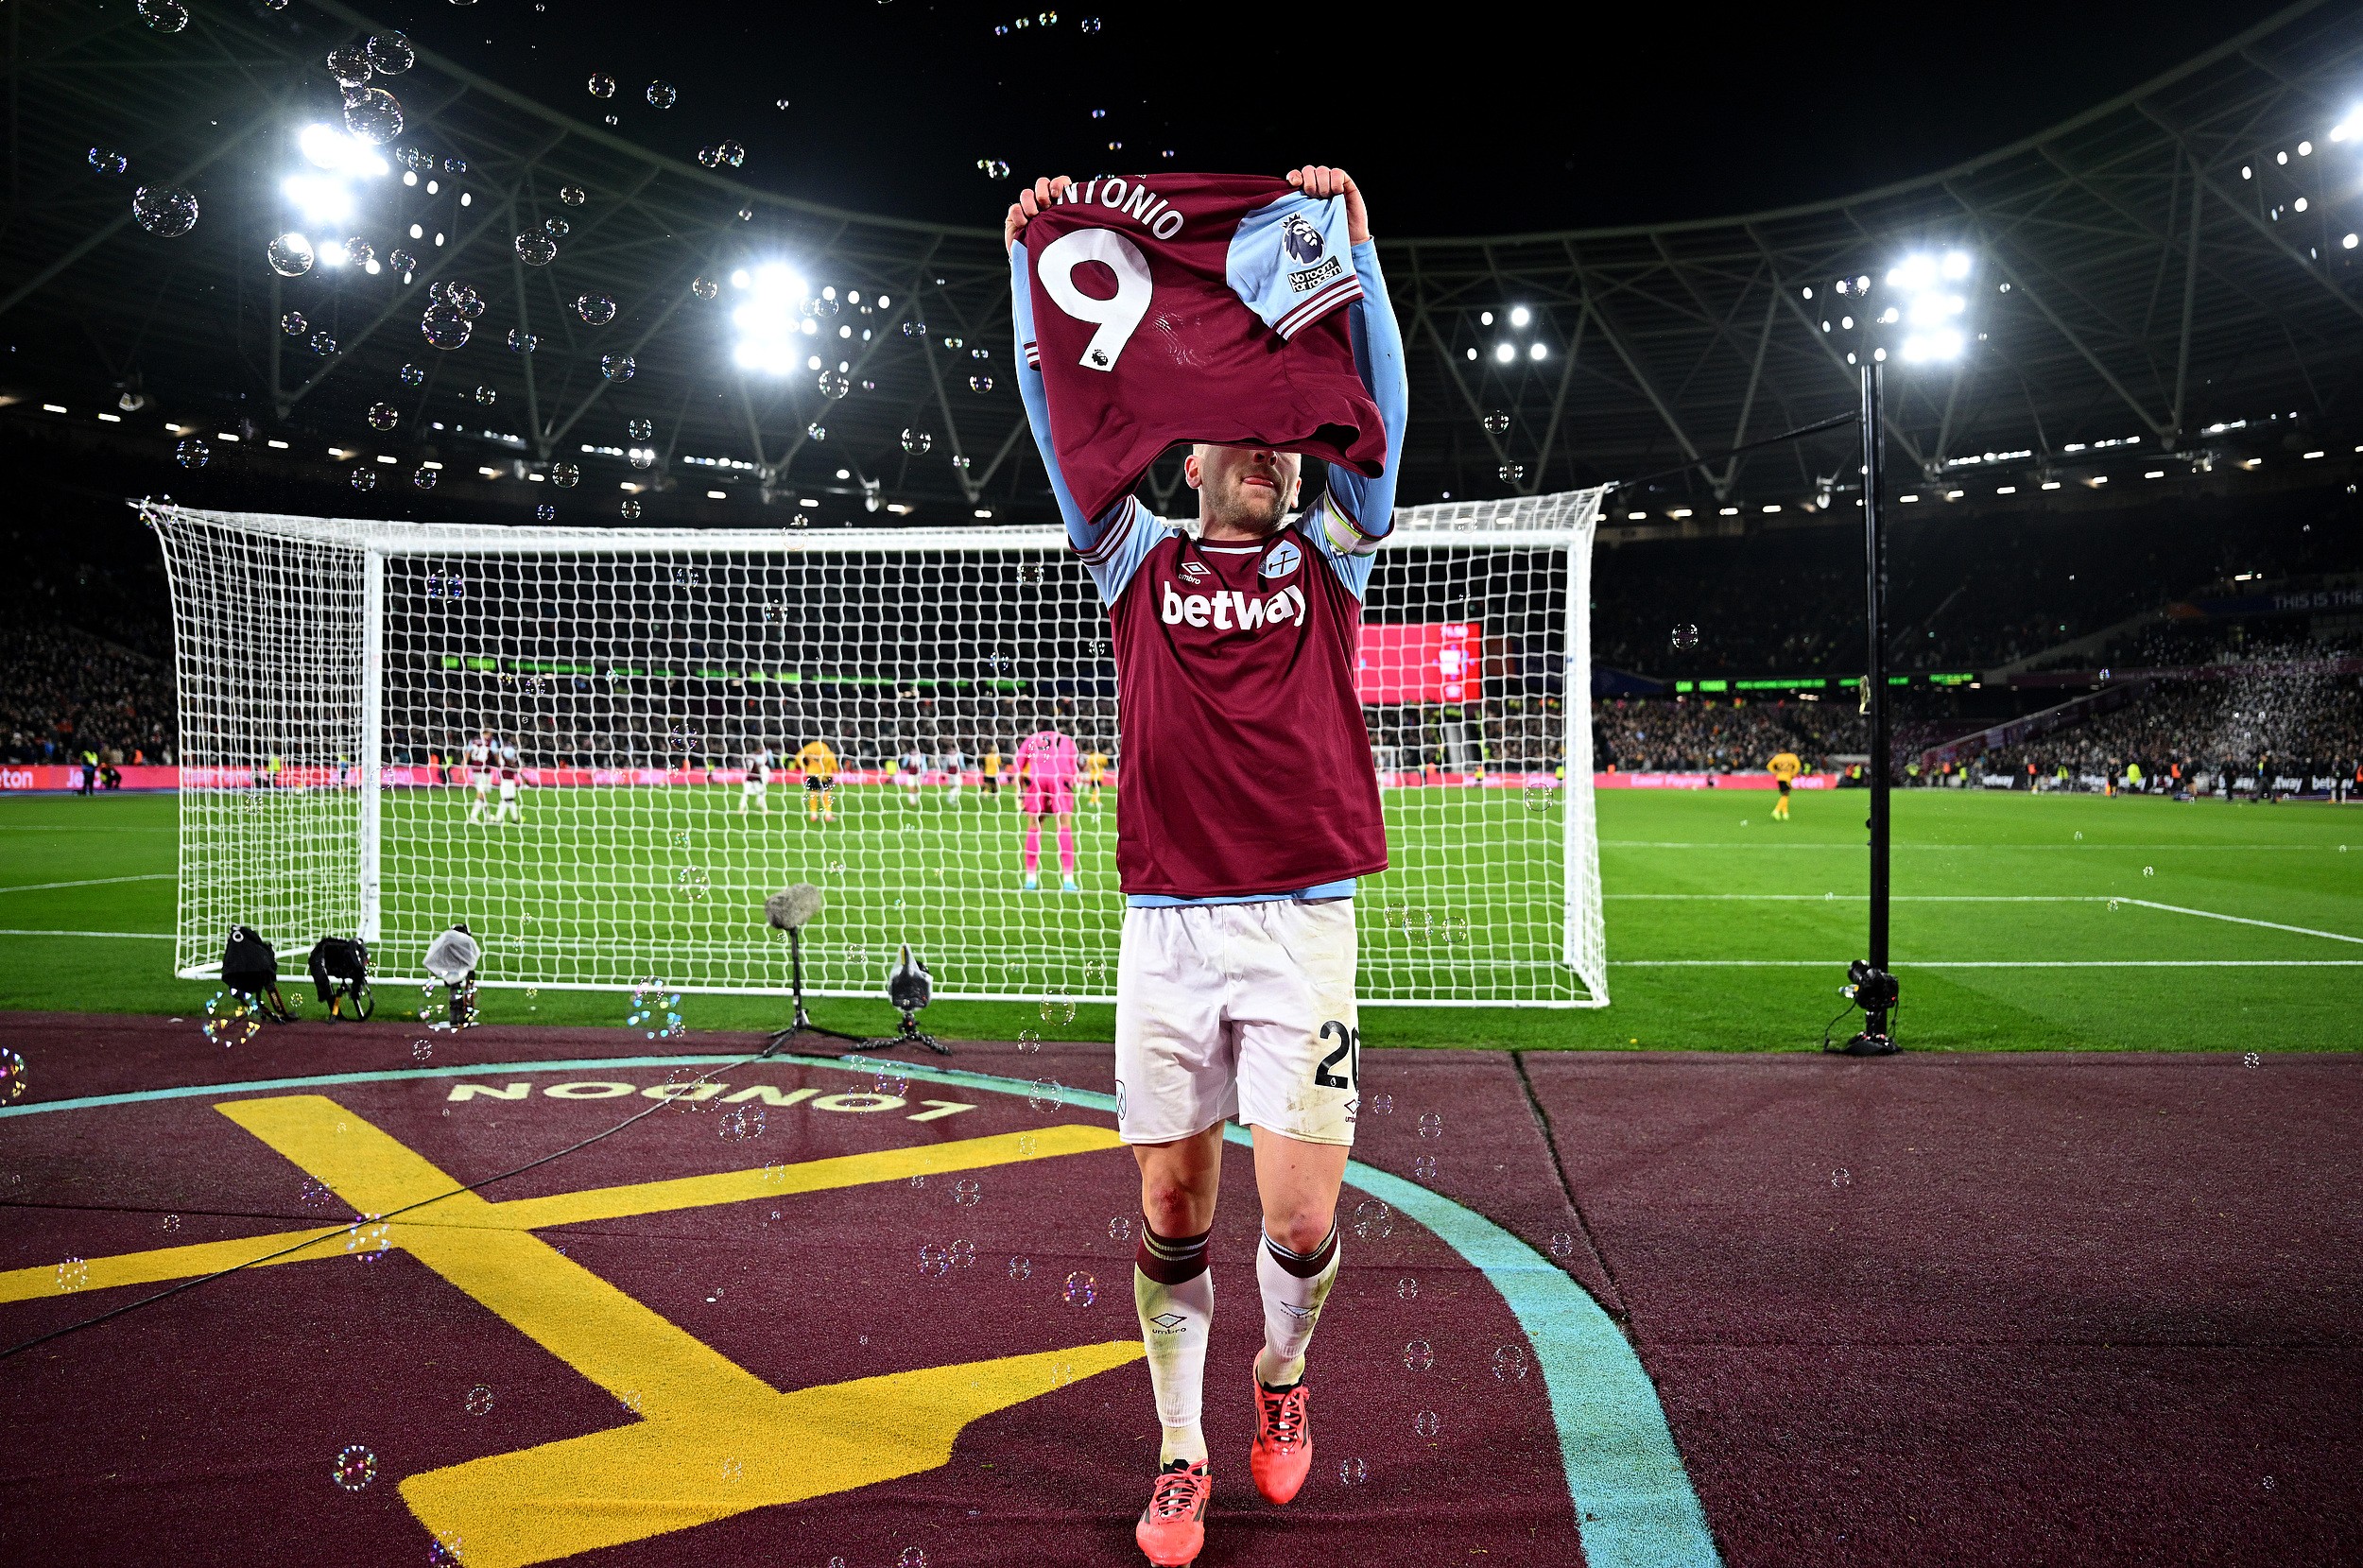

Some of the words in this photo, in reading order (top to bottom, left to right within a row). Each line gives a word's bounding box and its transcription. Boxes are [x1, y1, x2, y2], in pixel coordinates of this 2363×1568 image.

[1057, 177, 1184, 240] NTONIO
[1288, 272, 1305, 284] No
[1305, 261, 1334, 280] room
[1292, 282, 1307, 292] for
[1308, 266, 1342, 288] racism
[1038, 228, 1153, 372] 9
[1178, 574, 1201, 584] umbro
[1791, 772, 1824, 788] eton
[447, 1081, 977, 1122] LONDON
